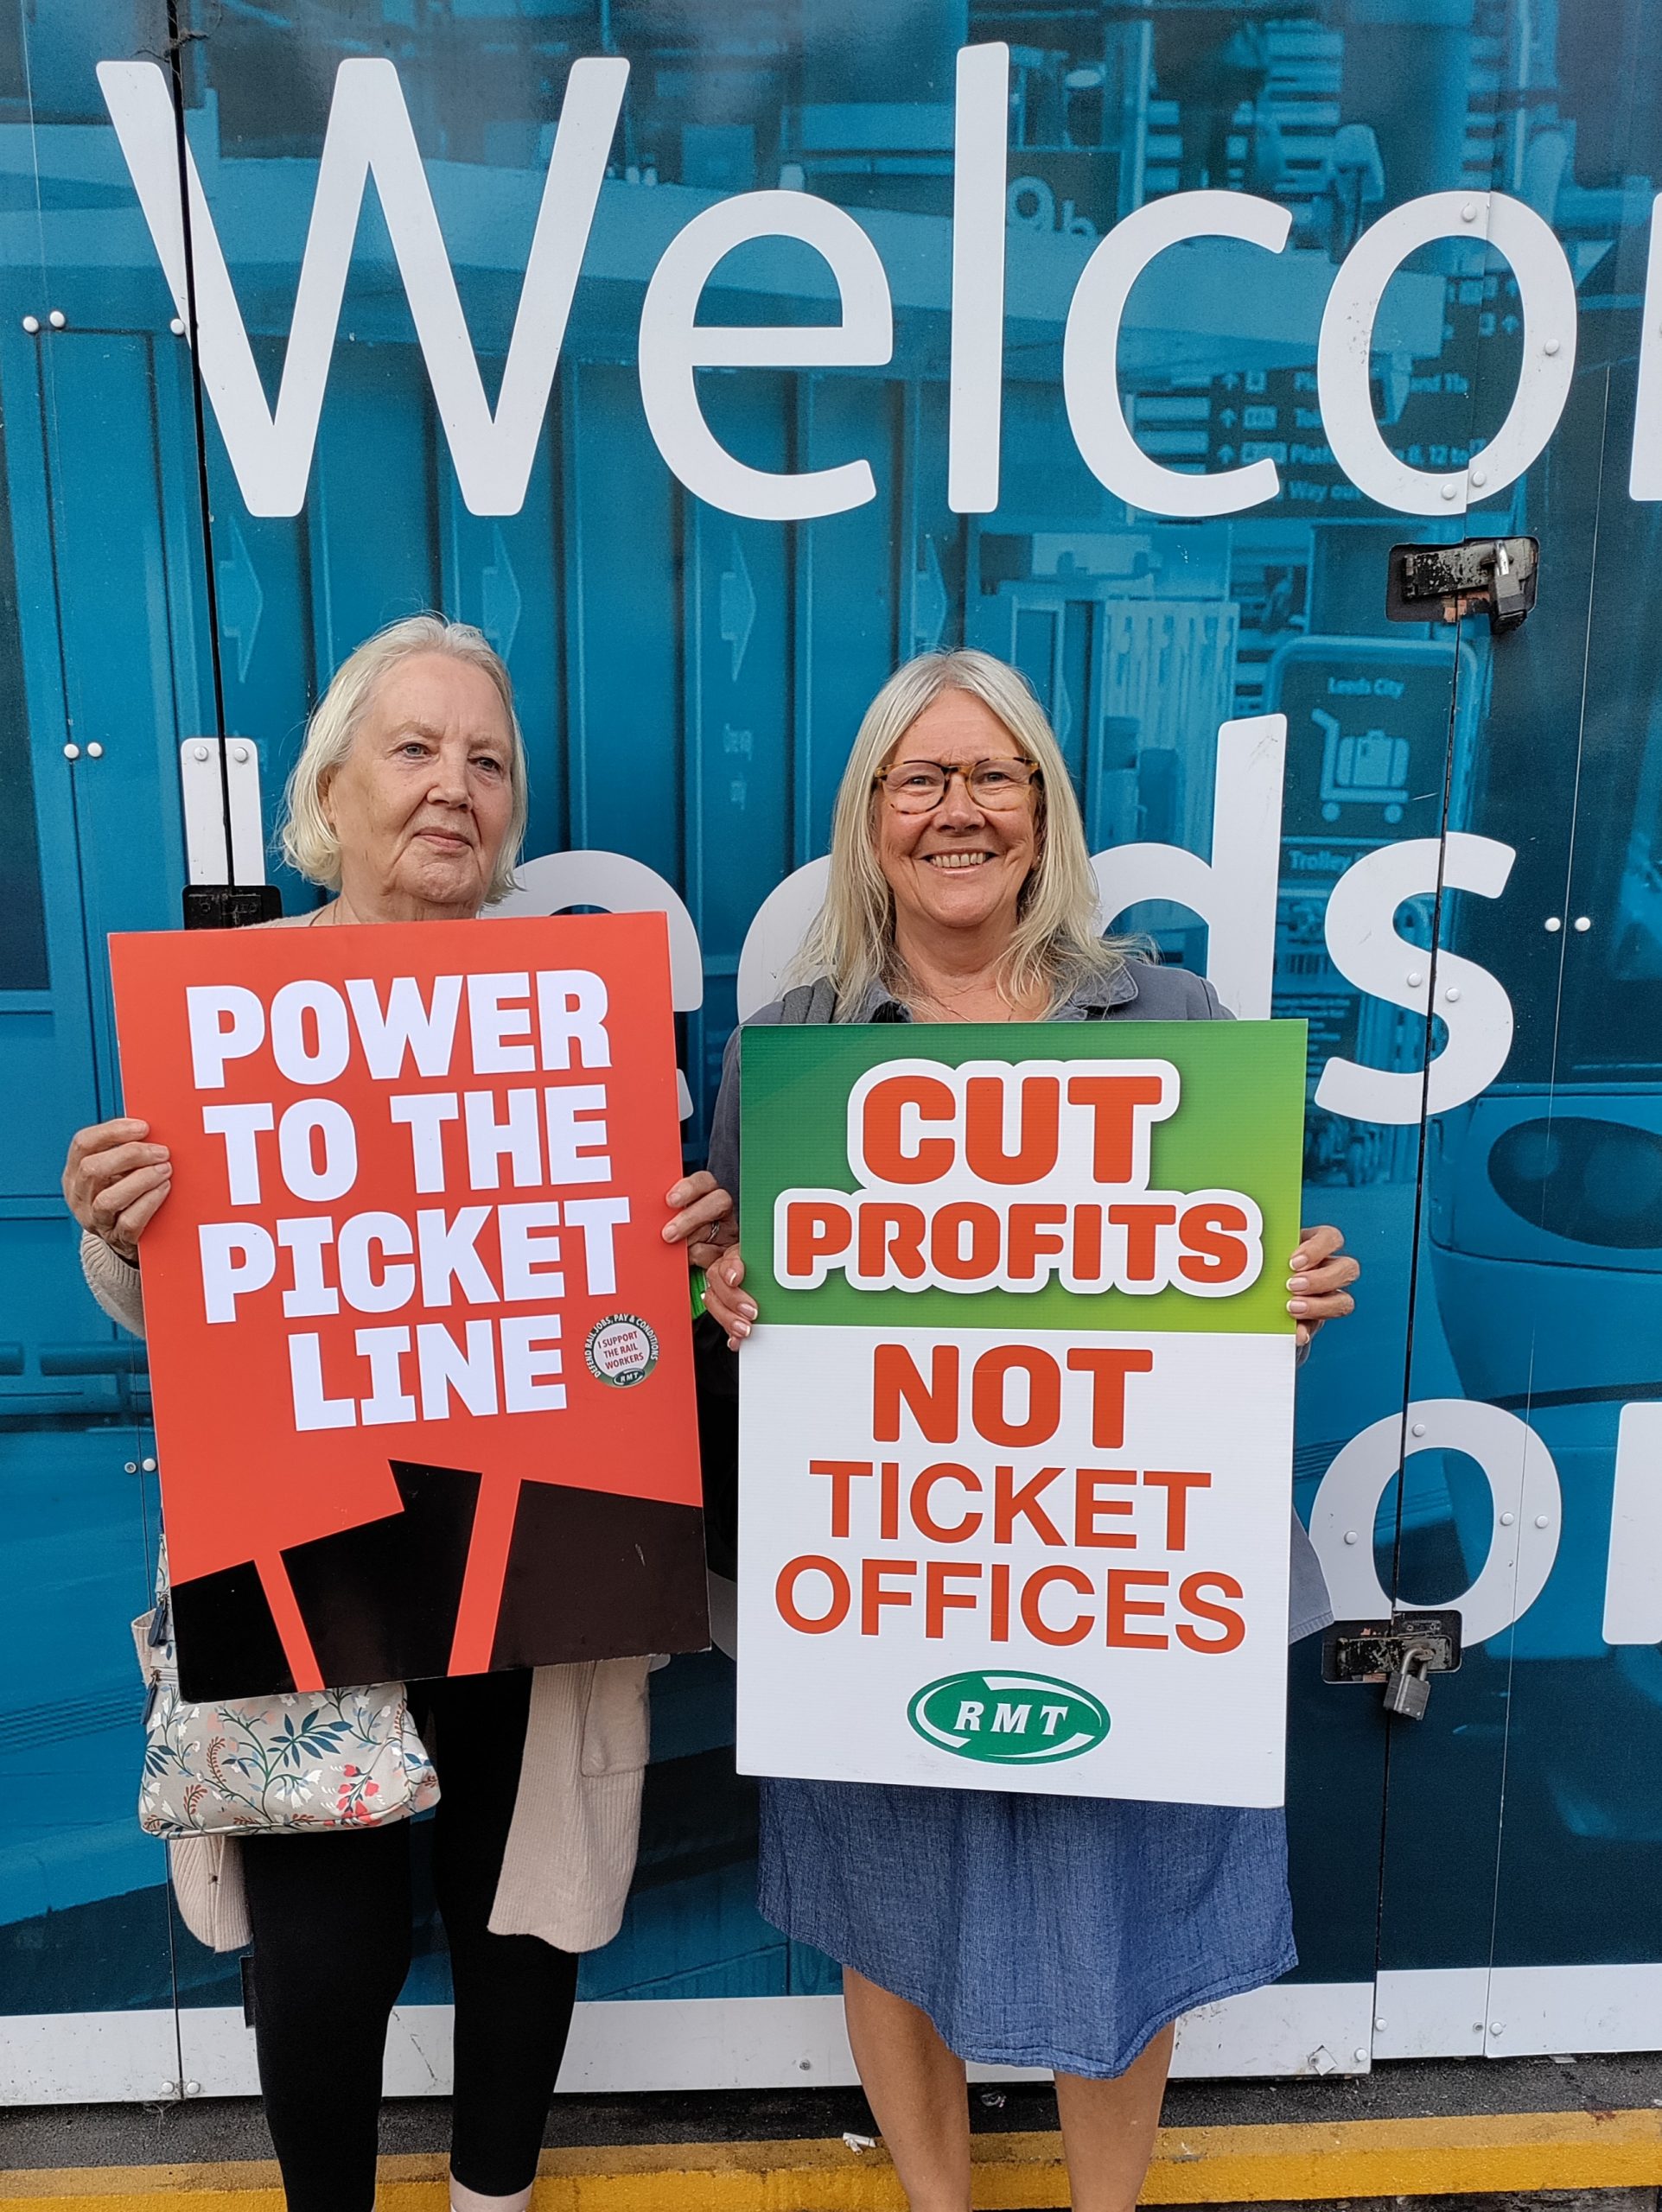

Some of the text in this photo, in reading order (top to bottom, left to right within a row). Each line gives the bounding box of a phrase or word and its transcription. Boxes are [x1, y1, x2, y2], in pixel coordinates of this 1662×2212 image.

[96, 41, 1662, 521] Welco
[185, 969, 612, 1090] POWER
[202, 1084, 612, 1206] TO THE
[863, 1075, 1162, 1185] CUT
[197, 1196, 631, 1325] PICKET
[786, 1201, 1248, 1284] PROFITS
[585, 1332, 595, 1349] RAIL
[602, 1331, 638, 1348] SUPPORT
[603, 1343, 639, 1359] THE RAIL
[614, 1313, 629, 1322] PAY
[636, 1318, 659, 1361] CONDITIONS
[288, 1313, 568, 1432] LINE
[584, 1350, 602, 1378] DEFEND
[605, 1352, 644, 1370] WORKERS
[620, 1371, 639, 1382] RMT
[873, 1344, 1153, 1449] NOT
[809, 1459, 1212, 1552] TICKET
[775, 1554, 1246, 1655] OFFICES
[954, 1700, 1069, 1737] RMT
